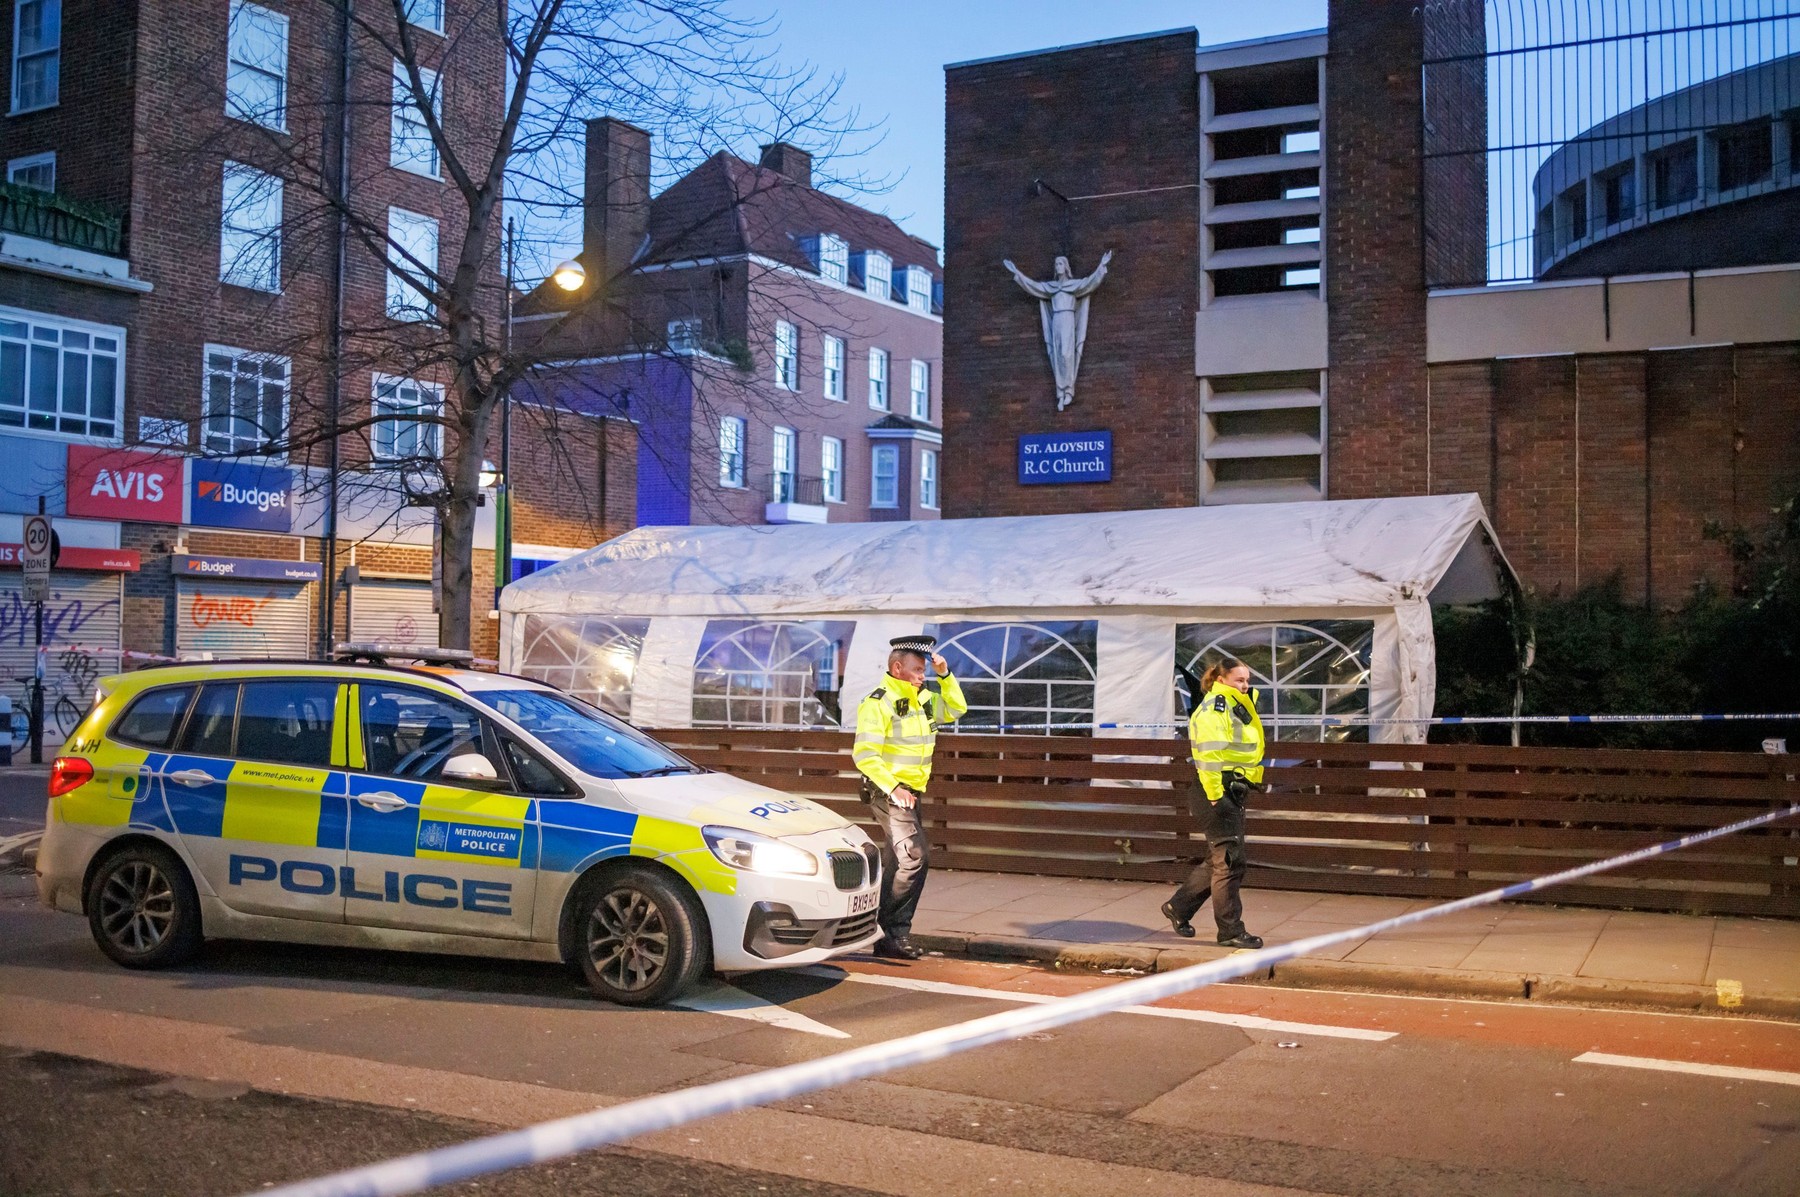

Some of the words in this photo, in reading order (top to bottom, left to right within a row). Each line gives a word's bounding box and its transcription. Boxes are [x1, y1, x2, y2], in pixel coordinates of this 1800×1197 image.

[1024, 444, 1042, 454] ST.
[1044, 441, 1105, 453] ALOYSIUS
[1023, 460, 1050, 474] R.C
[1053, 457, 1105, 473] Church
[91, 469, 164, 502] AVIS
[223, 484, 287, 512] Budget
[29, 529, 46, 544] 20
[26, 559, 47, 569] ZONE
[201, 561, 234, 575] Budget
[285, 569, 317, 578] budget.co.uk
[749, 800, 812, 820] POLI
[454, 828, 517, 841] METROPOLITAN
[461, 839, 506, 852] POLICE
[229, 854, 512, 915] POLICE
